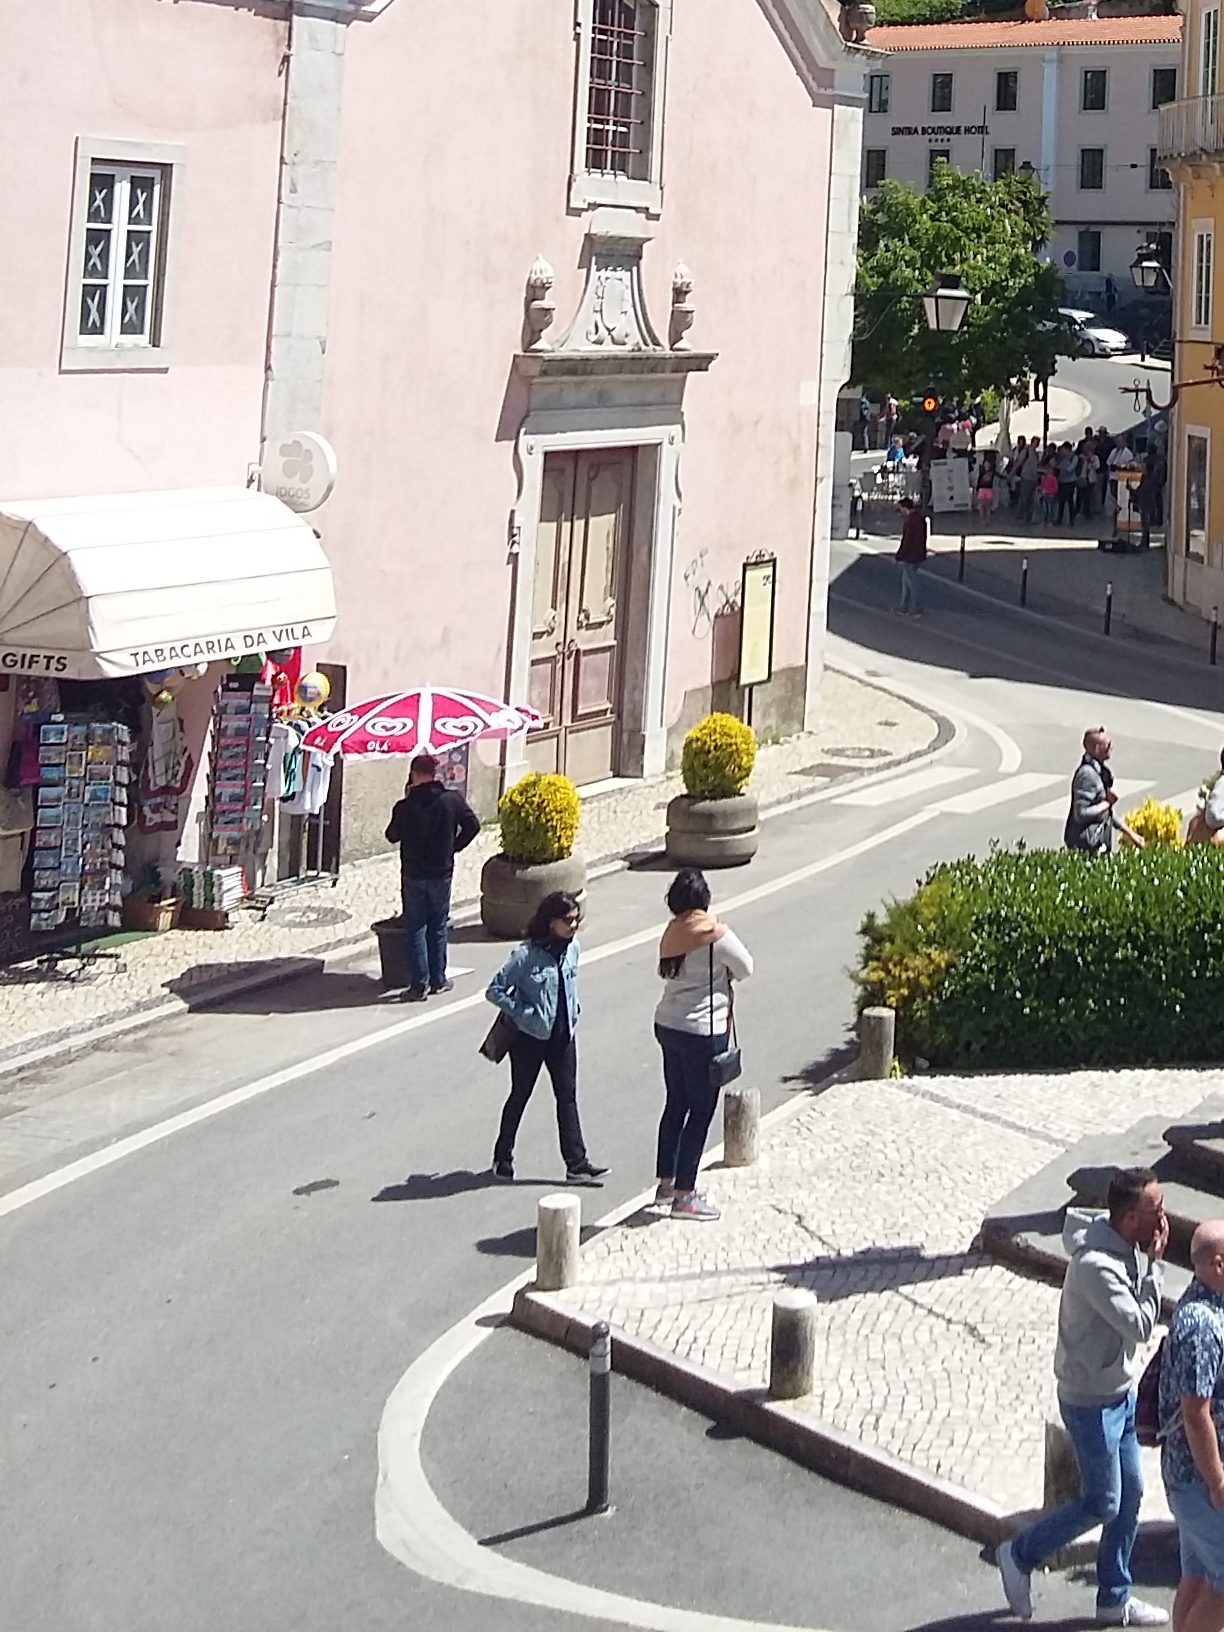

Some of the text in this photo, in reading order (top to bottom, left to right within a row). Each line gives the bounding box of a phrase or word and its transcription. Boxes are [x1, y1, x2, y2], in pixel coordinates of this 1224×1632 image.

[891, 125, 990, 136] SINTRA BOUTIQUE HOTEL
[130, 625, 312, 667] TABACARIA DA VILA
[2, 652, 68, 672] GIFTS
